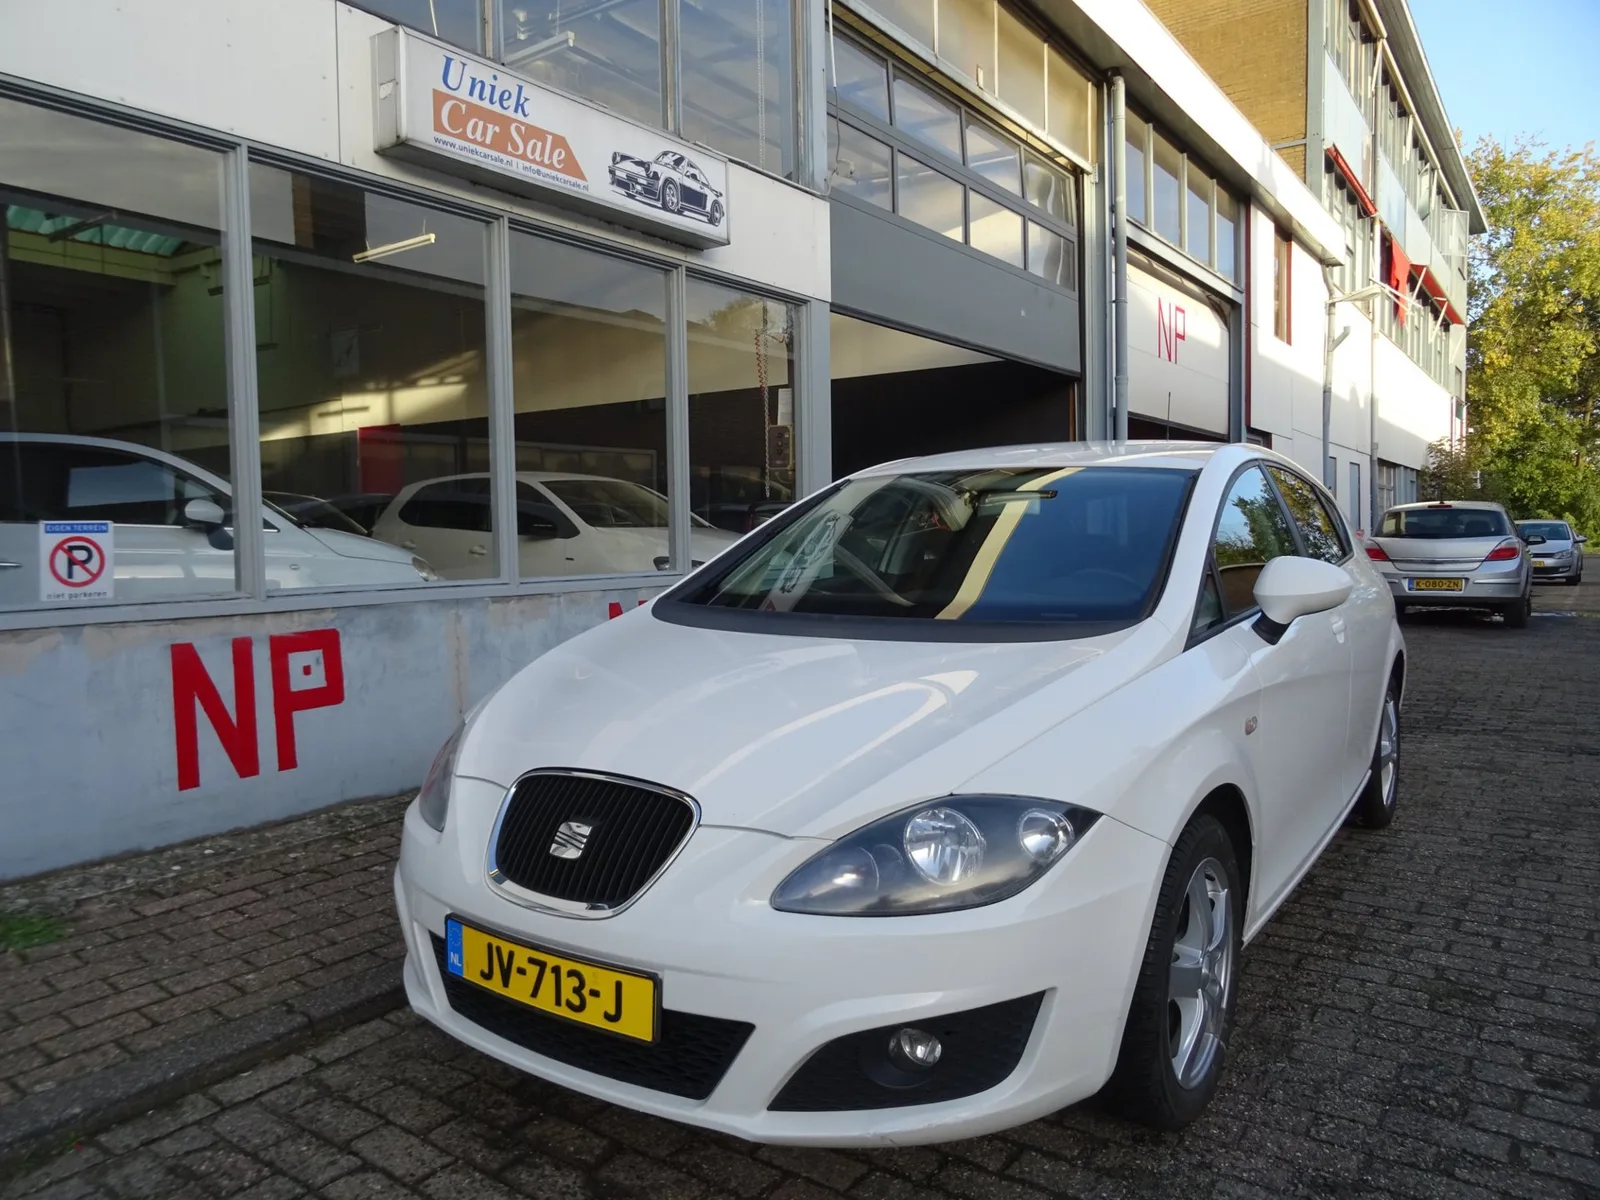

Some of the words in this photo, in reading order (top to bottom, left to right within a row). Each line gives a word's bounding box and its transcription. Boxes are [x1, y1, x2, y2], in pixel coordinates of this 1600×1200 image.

[441, 54, 530, 118] Uniek
[433, 136, 513, 168] www.uniekcarsale.nl
[522, 163, 589, 192] info@uniekcarsale.nl
[441, 100, 500, 145] Car
[507, 122, 566, 169] Sale
[1158, 297, 1186, 364] NP
[46, 524, 71, 532] EIGEN
[74, 524, 107, 532] TERREIN
[46, 592, 65, 600] niet
[68, 591, 108, 600] parkeren
[1415, 580, 1459, 588] K-080-ZN
[170, 628, 345, 791] NP
[450, 952, 462, 967] NL
[480, 942, 623, 1023] JV-713-J
